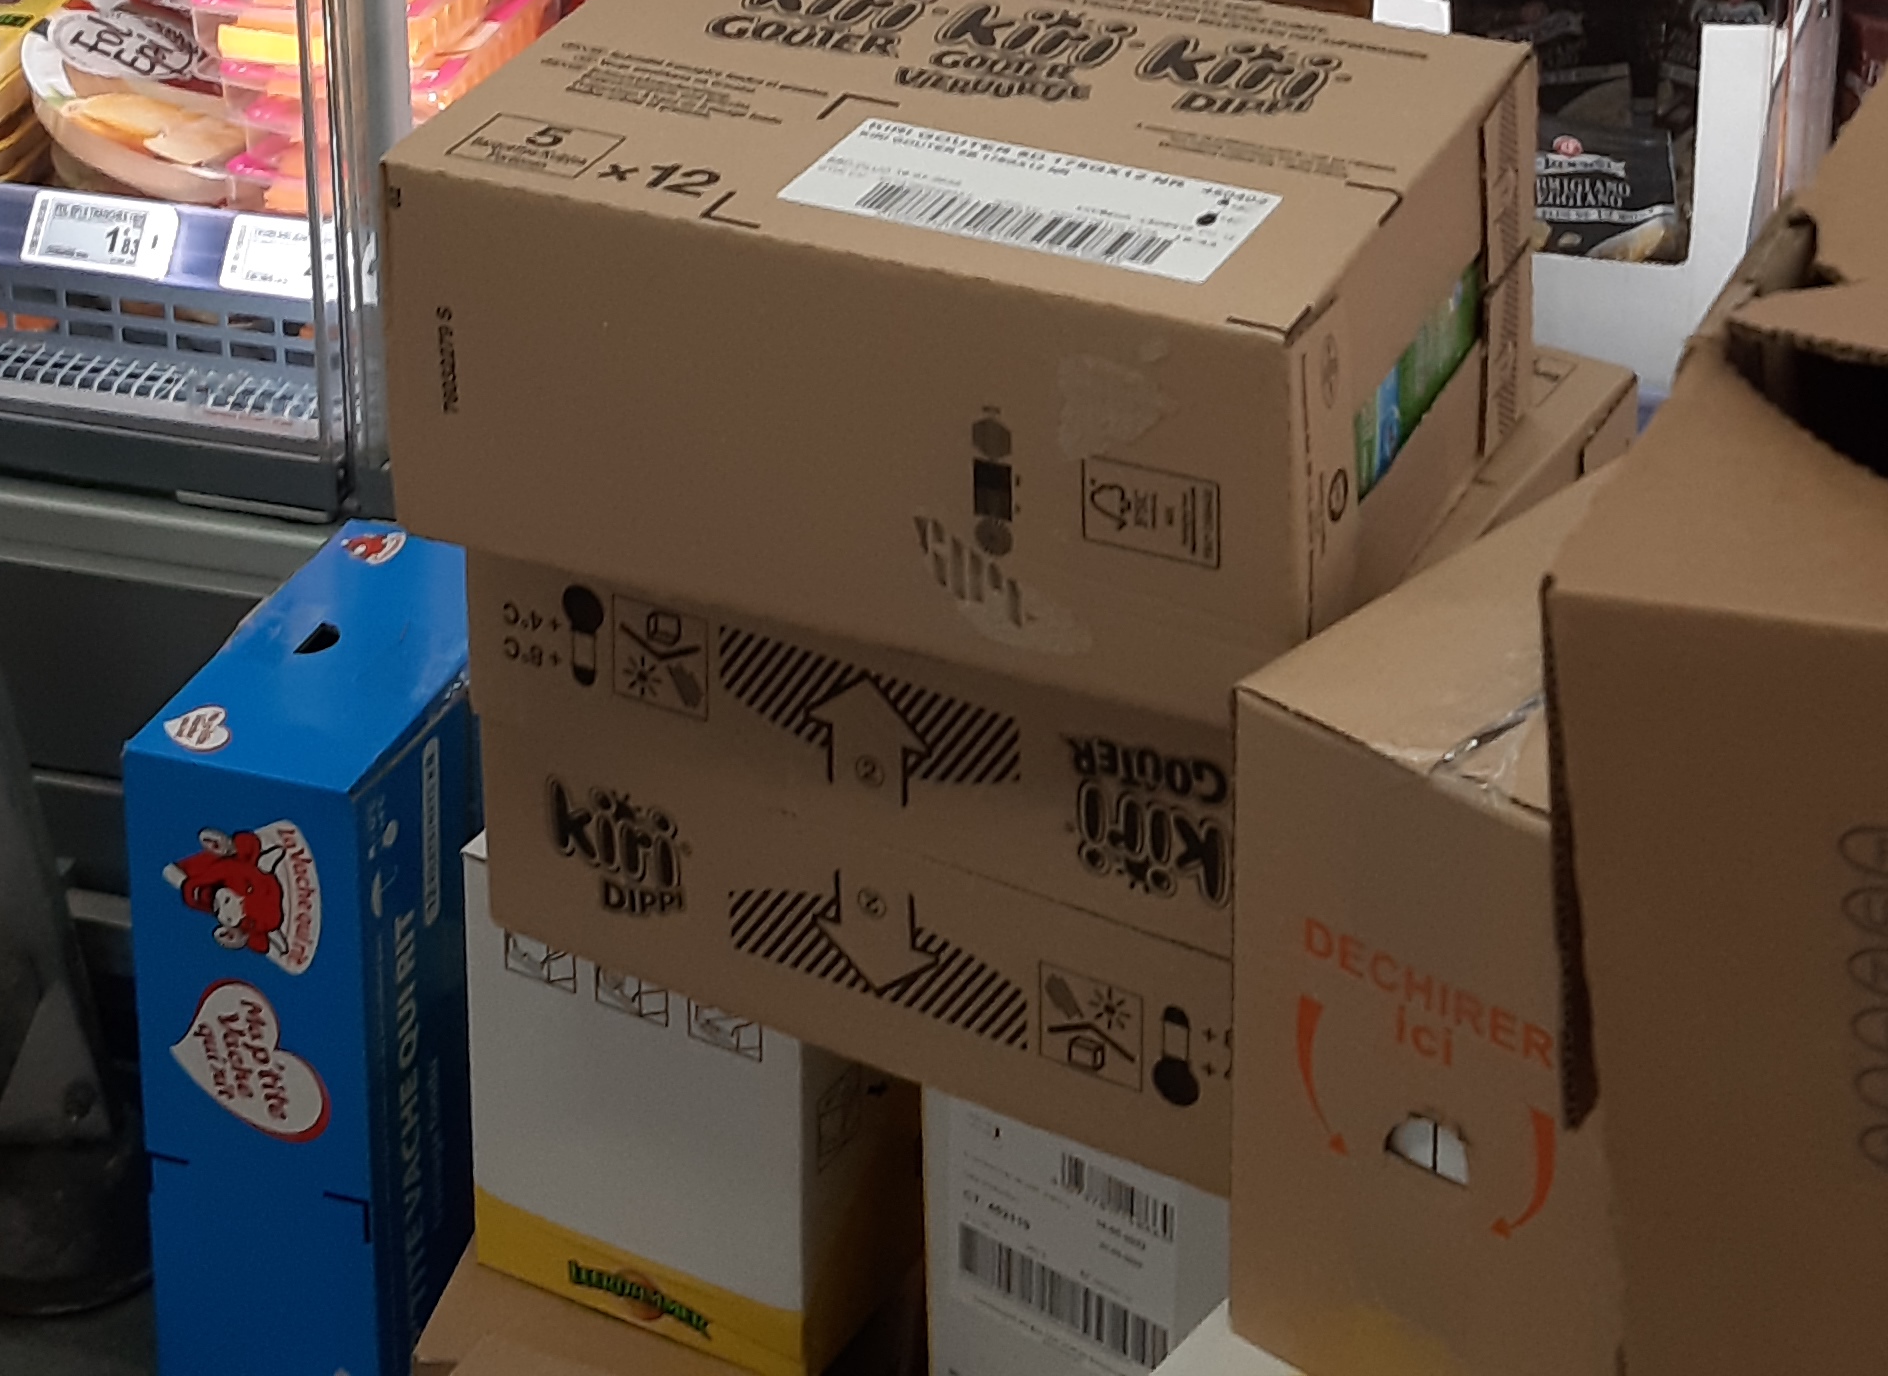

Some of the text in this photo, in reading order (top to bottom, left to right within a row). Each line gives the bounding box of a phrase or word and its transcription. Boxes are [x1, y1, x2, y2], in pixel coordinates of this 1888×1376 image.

[932, 3, 1138, 70] kiri
[1135, 35, 1343, 100] kiri
[523, 125, 572, 150] 5
[645, 160, 722, 199] 12
[546, 778, 685, 891] kiri
[599, 877, 686, 918] DIPPI
[1301, 917, 1556, 1072] DECHIRER
[1395, 1018, 1457, 1070] ici
